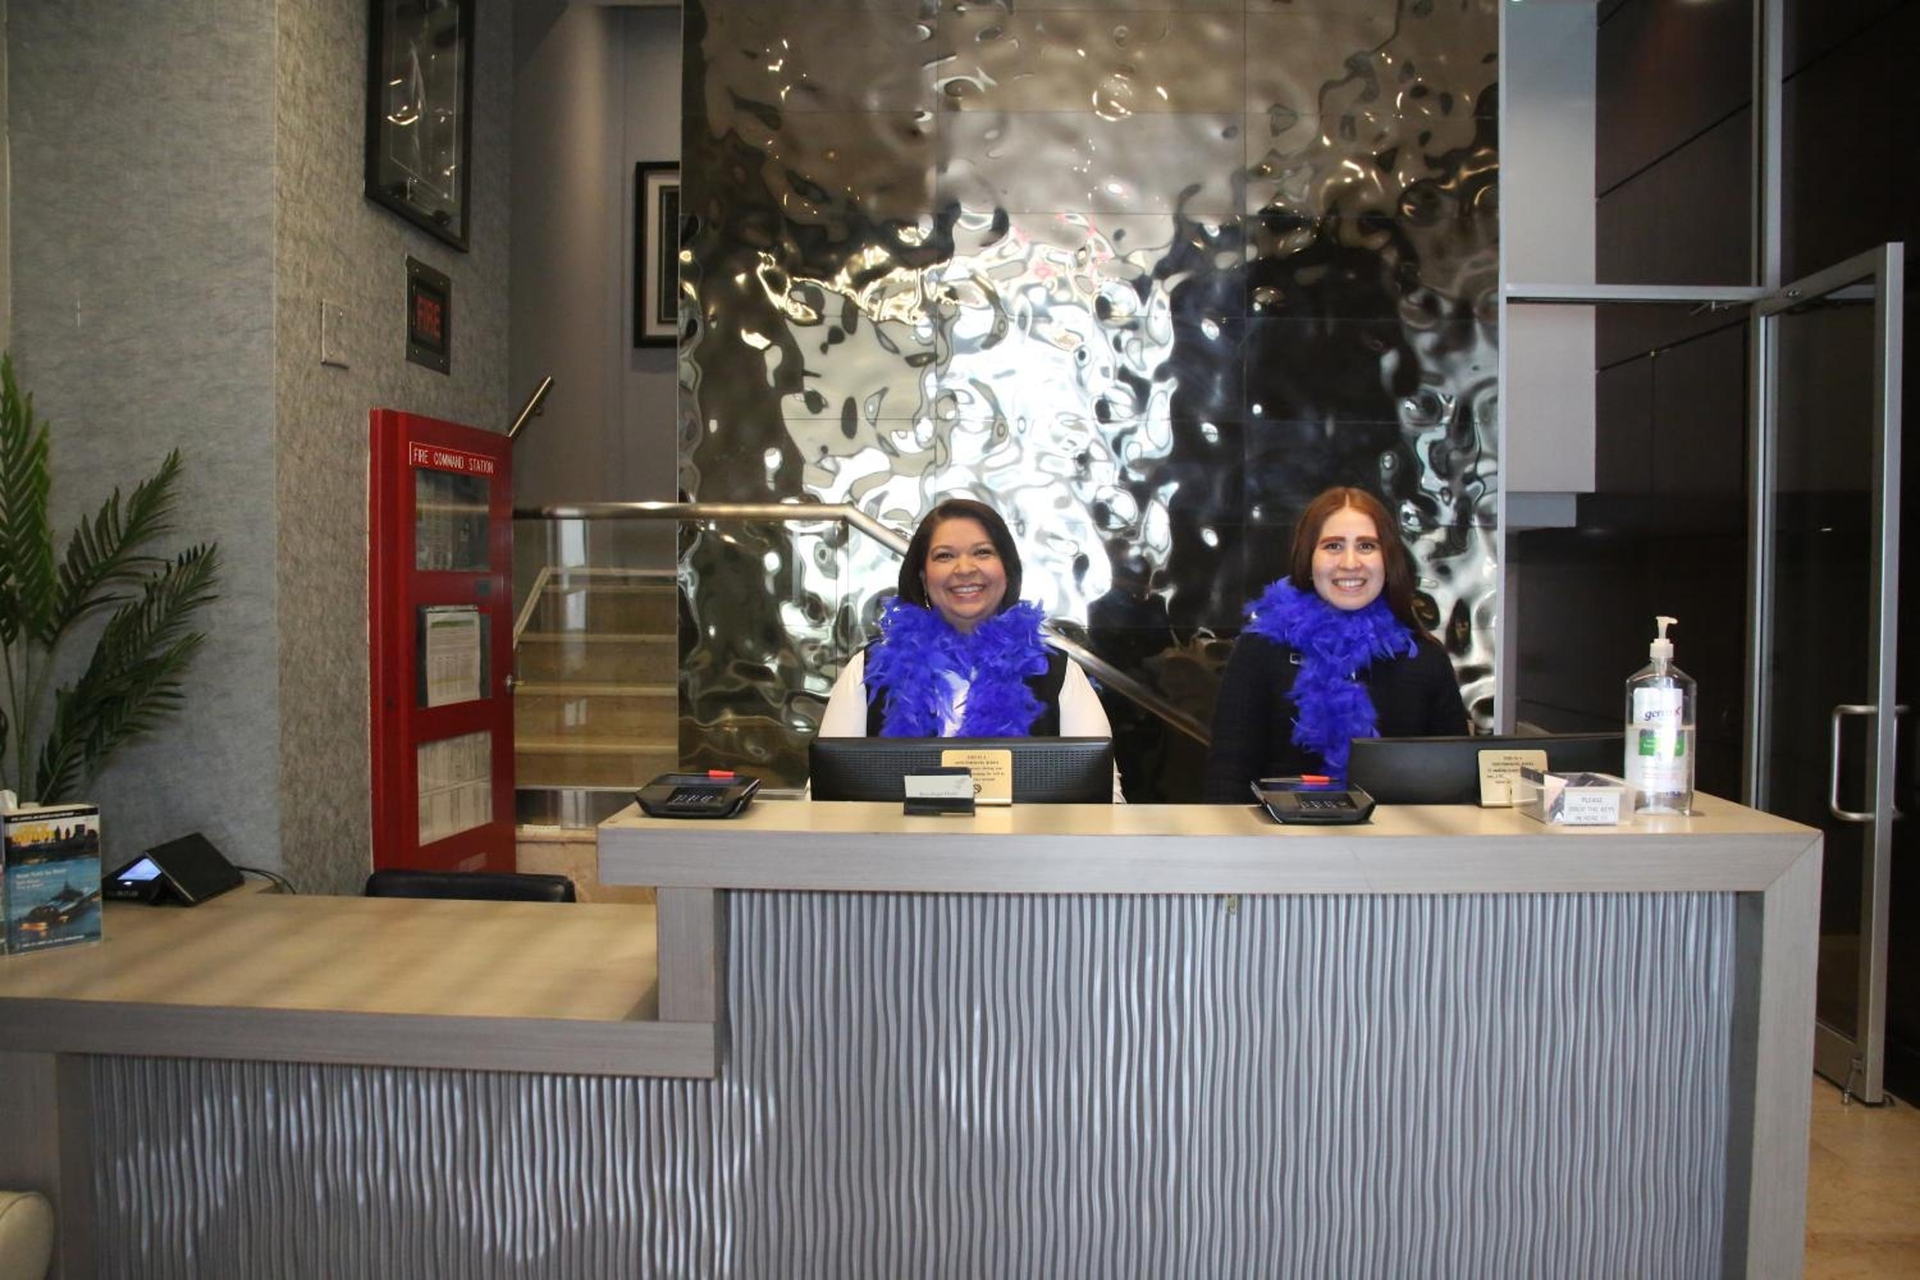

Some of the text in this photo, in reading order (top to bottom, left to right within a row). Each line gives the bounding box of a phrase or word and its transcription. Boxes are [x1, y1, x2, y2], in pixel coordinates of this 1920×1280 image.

[416, 294, 441, 339] FIRE
[413, 447, 495, 475] FIRE COMMAND STATION
